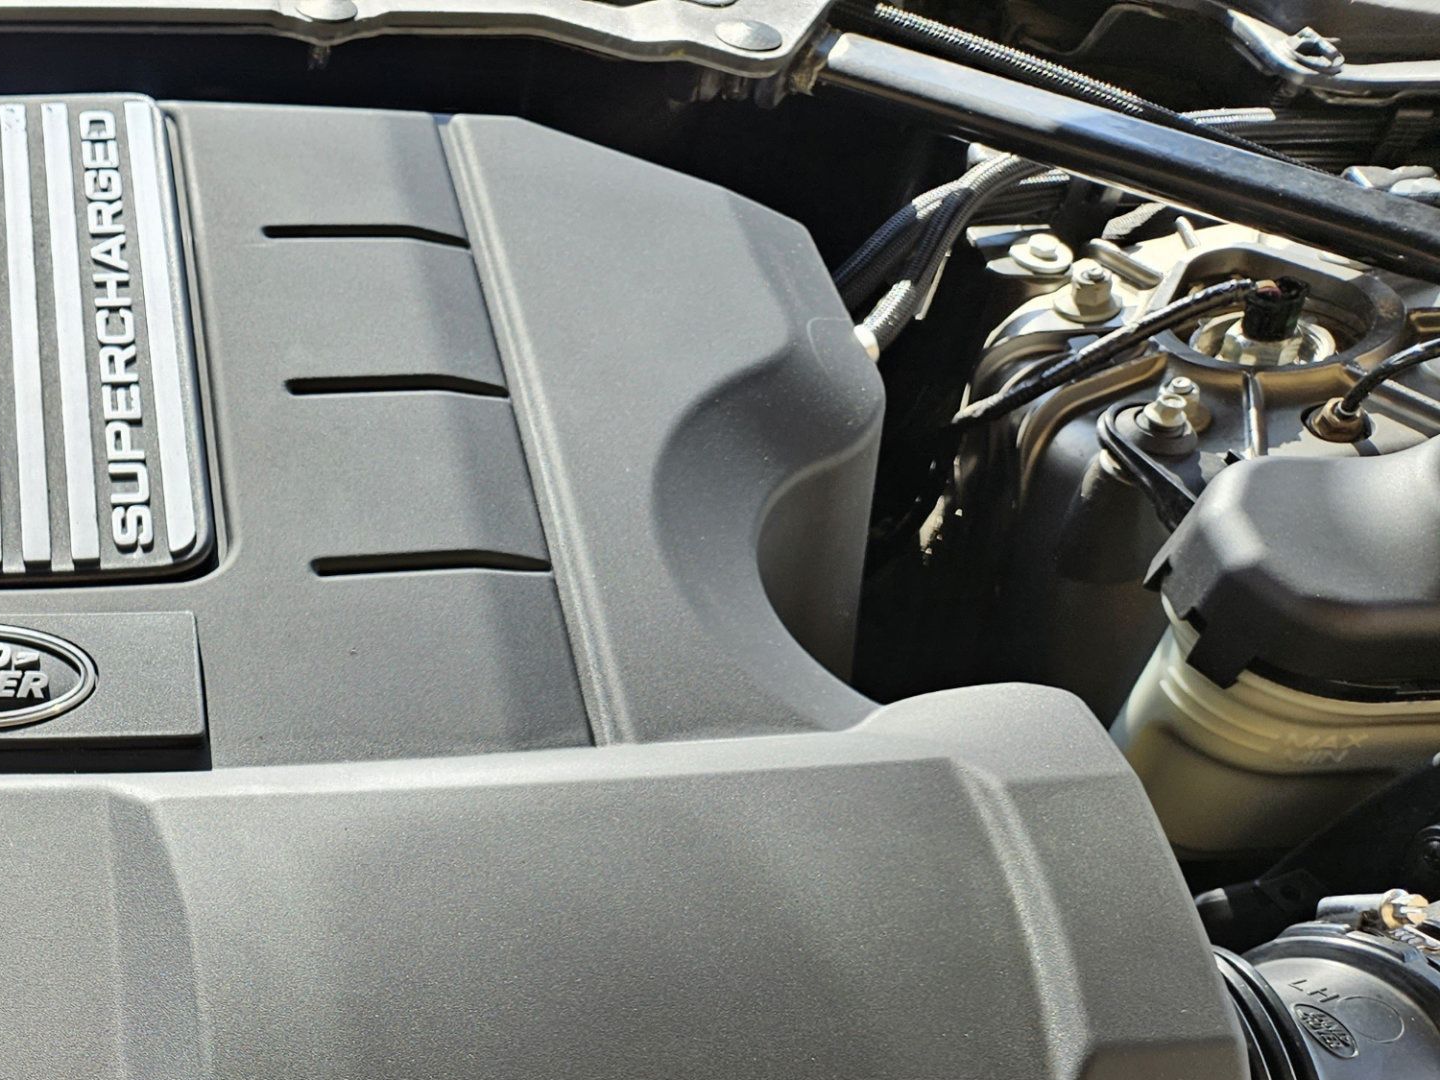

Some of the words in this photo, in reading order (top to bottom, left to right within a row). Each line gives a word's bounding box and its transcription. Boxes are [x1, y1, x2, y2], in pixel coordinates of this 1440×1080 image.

[79, 110, 154, 552] SUPERCHARGED
[1286, 732, 1369, 749] MAX
[1285, 748, 1350, 764] MIN
[1288, 979, 1340, 1003] LH
